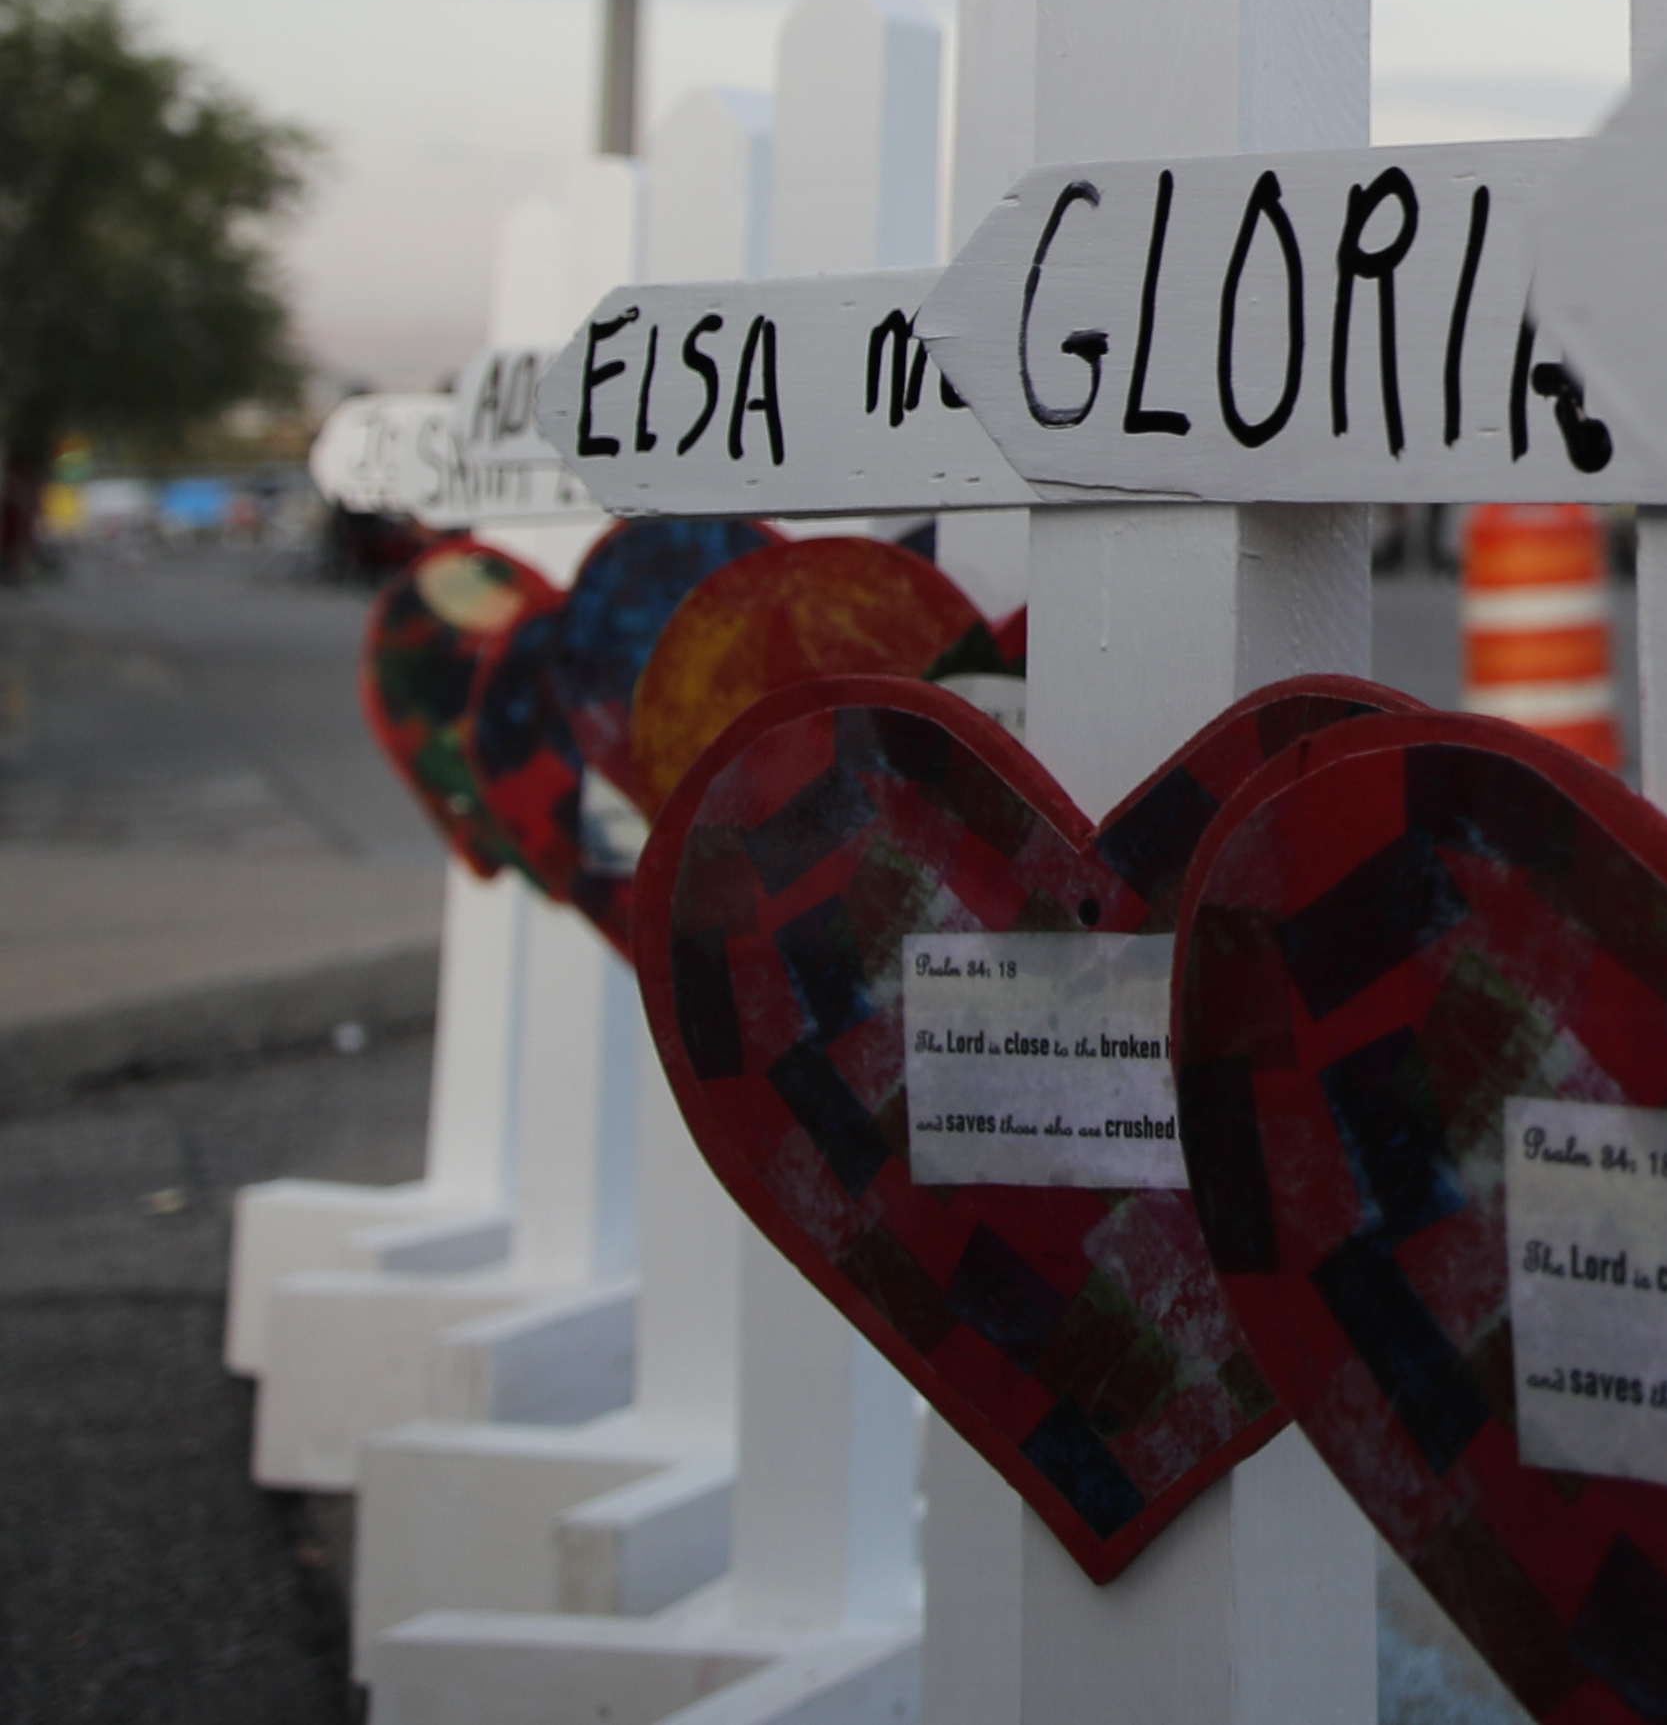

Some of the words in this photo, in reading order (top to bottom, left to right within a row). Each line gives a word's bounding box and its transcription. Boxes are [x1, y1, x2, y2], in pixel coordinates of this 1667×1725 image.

[915, 953, 961, 977] Psalm
[999, 960, 1017, 979] 18
[915, 1030, 943, 1054] The
[946, 1029, 984, 1054] Lord
[989, 1040, 1001, 1055] is
[1004, 1031, 1049, 1056] close
[1054, 1039, 1069, 1057] to
[1074, 1036, 1098, 1057] the
[1100, 1033, 1161, 1059] broken
[916, 1115, 943, 1133] and
[945, 1113, 996, 1133] saves
[1000, 1115, 1038, 1136] those
[1104, 1115, 1175, 1140] crushed
[1523, 1127, 1593, 1167] Psalm
[1523, 1240, 1566, 1278] The
[1569, 1244, 1627, 1287] Lord
[1526, 1368, 1565, 1393] and
[1568, 1368, 1645, 1405] saves
